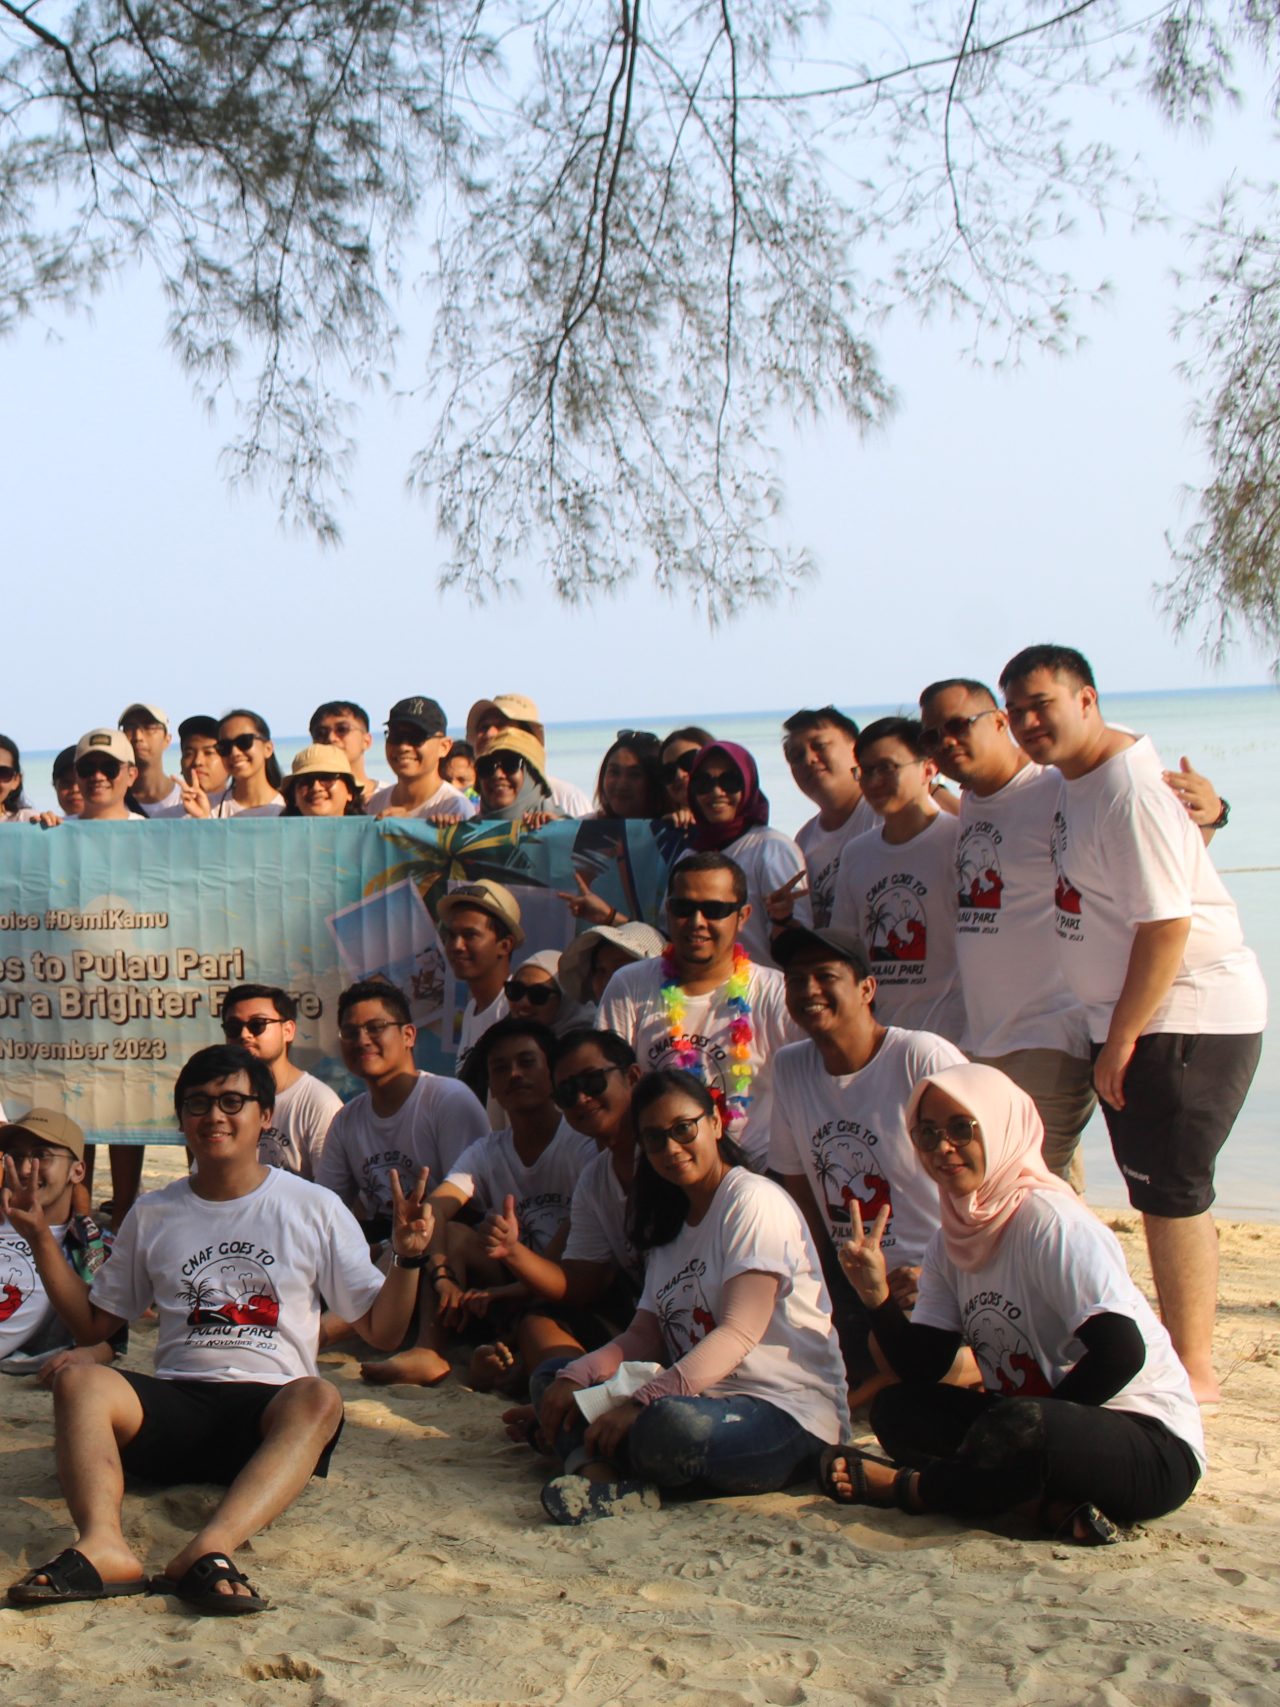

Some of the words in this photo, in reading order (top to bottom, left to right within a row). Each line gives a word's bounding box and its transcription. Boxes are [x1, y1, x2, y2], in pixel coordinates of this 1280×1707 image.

[866, 876, 888, 902] CNAF
[913, 880, 928, 897] TO
[45, 908, 168, 930] #DemiKamu
[972, 911, 997, 925] PARI
[31, 951, 65, 982] to
[73, 949, 168, 981] Pulau
[176, 947, 245, 980] Pari
[897, 964, 925, 977] PARI
[31, 991, 52, 1018] a
[59, 985, 201, 1024] Brighter
[112, 1038, 167, 1059] 2023
[709, 1043, 727, 1060] TO
[278, 1133, 290, 1147] TO
[812, 1122, 833, 1147] CNAF
[837, 1120, 861, 1134] GOES
[862, 1129, 879, 1146] TO
[182, 1246, 214, 1276] CNAF
[219, 1241, 255, 1255] GOES
[256, 1248, 275, 1266] TO
[980, 1291, 1002, 1306] GOES
[1002, 1301, 1021, 1320] TO
[187, 1326, 232, 1340] PULAU
[237, 1327, 274, 1339] PARI
[256, 1342, 278, 1350] 2023
